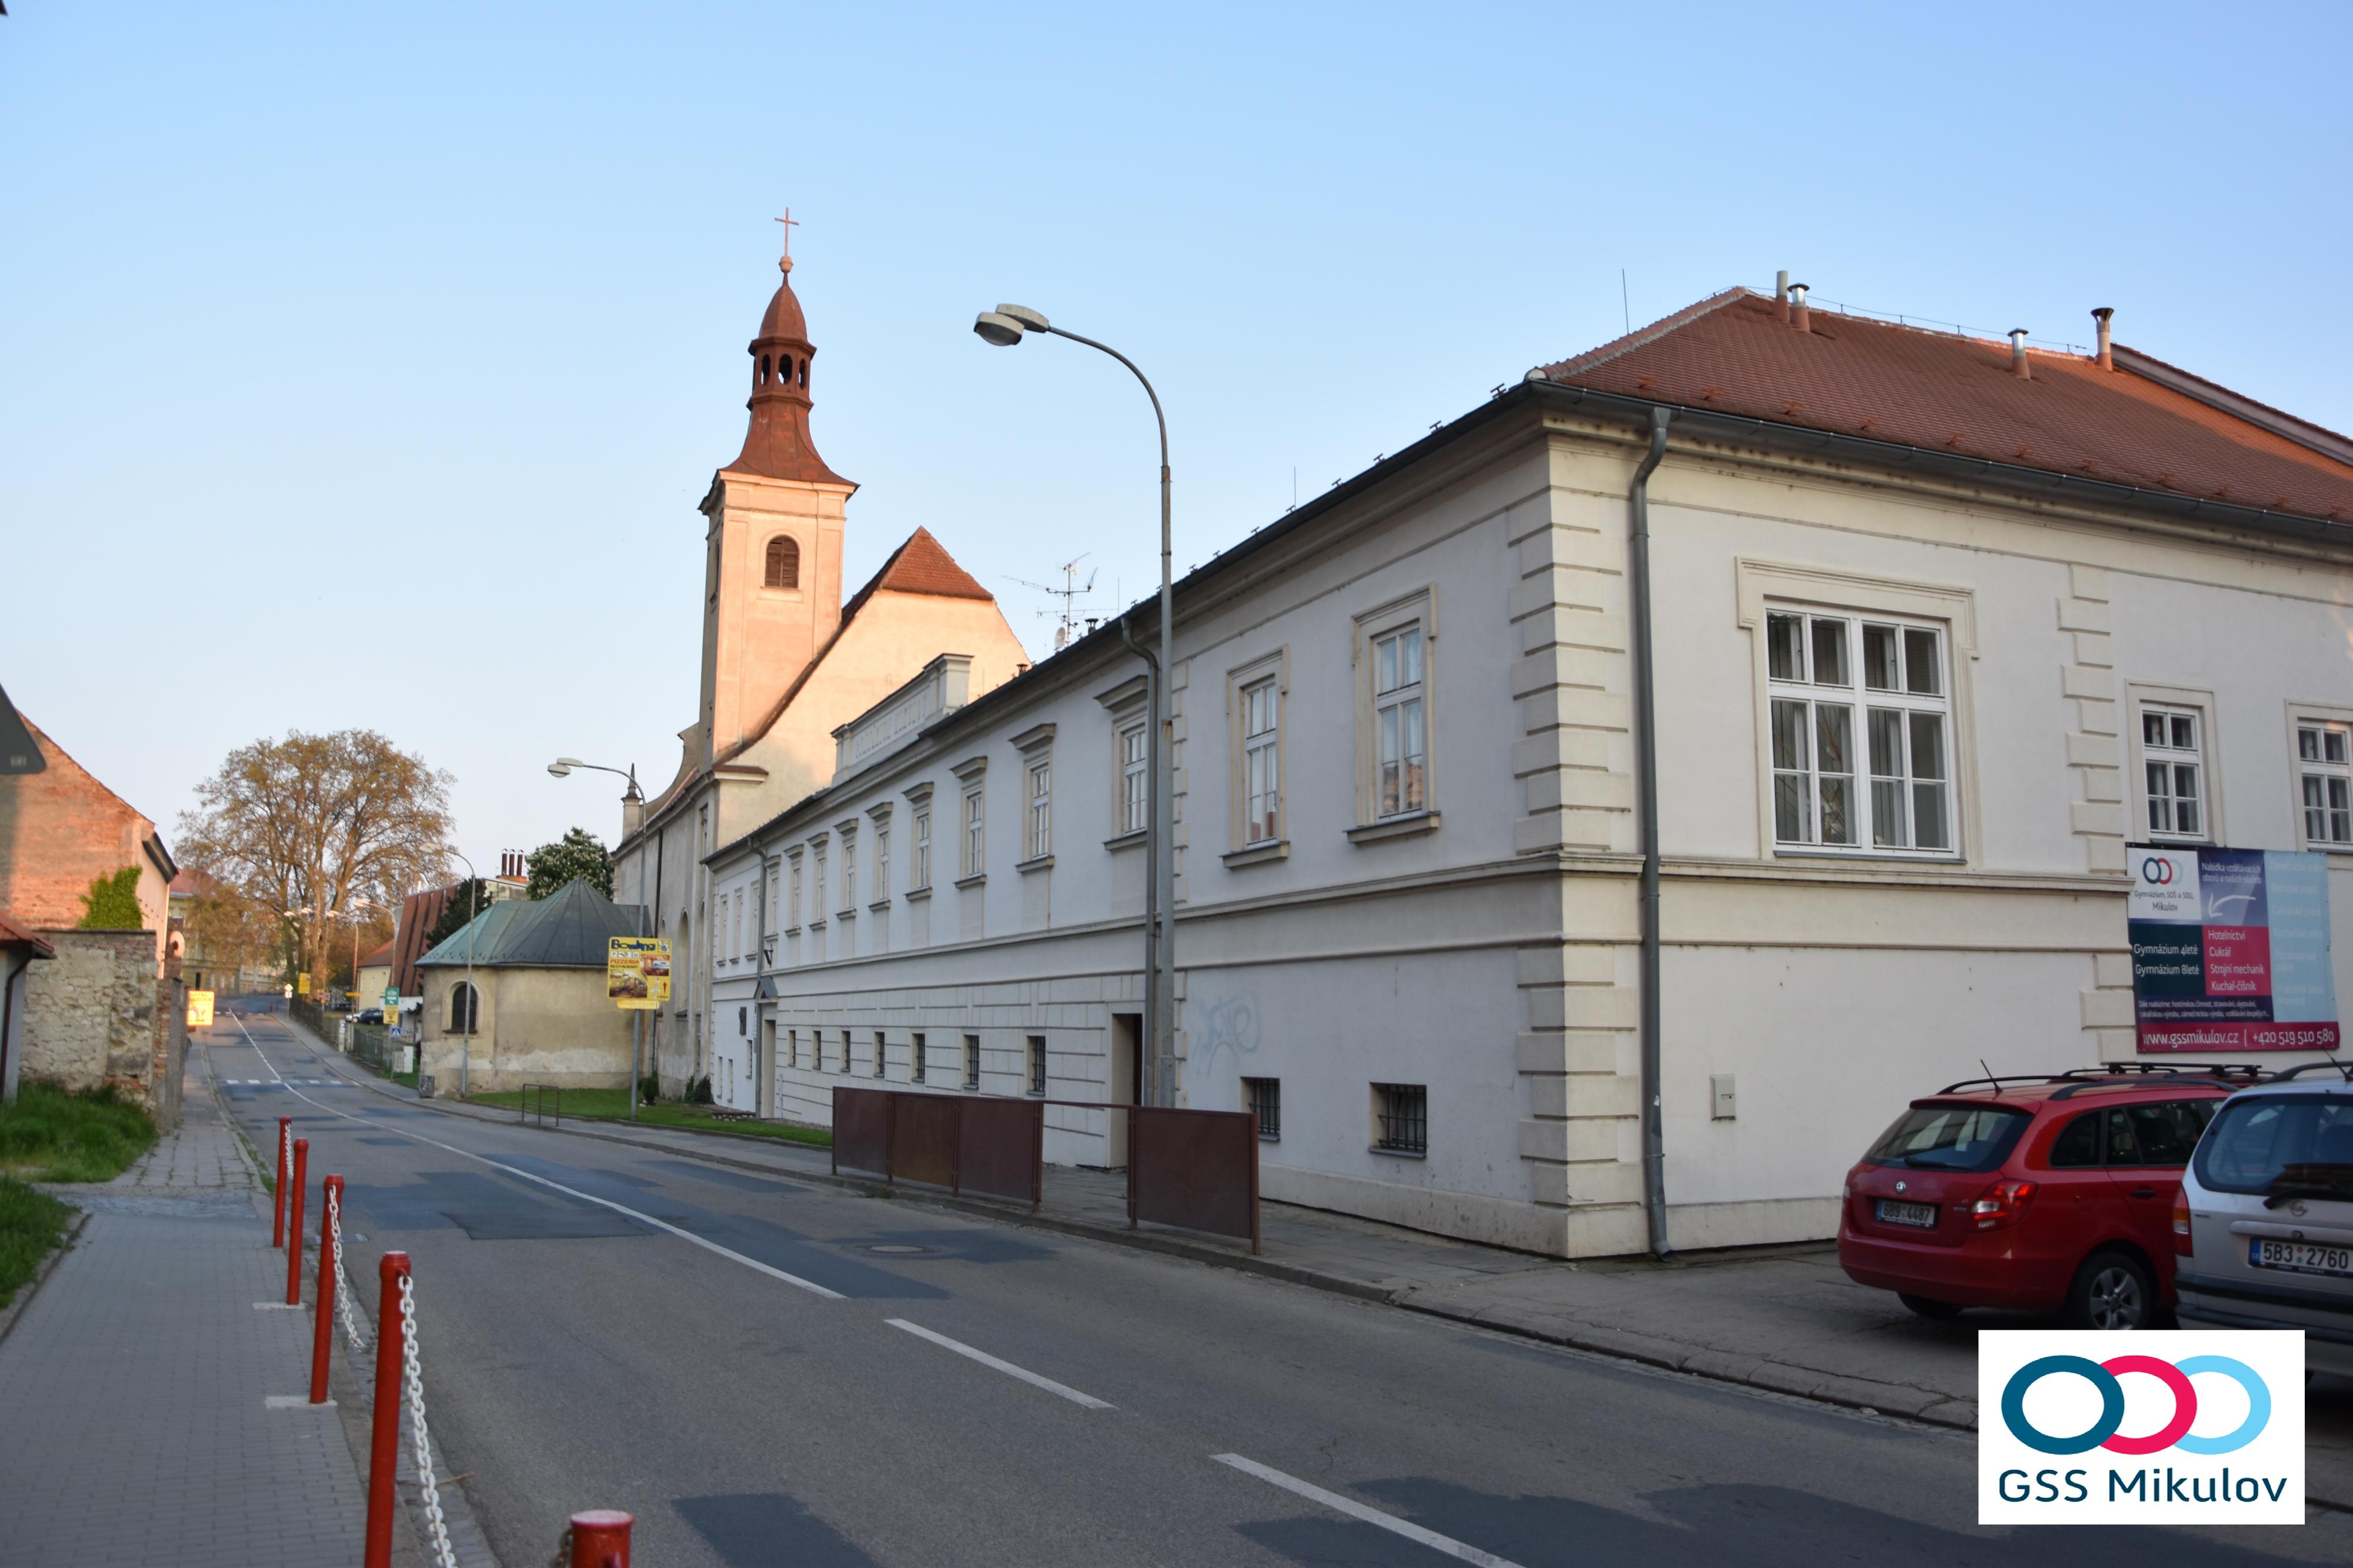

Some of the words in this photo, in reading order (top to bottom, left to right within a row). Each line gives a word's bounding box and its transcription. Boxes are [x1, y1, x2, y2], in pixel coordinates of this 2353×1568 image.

[2202, 862, 2225, 871] Nabídka
[2226, 863, 2261, 873] vzdělávacích
[2202, 873, 2218, 882] oborů
[2225, 874, 2242, 882] našich
[2167, 889, 2176, 899] SOŠ
[2152, 902, 2177, 911] Mikulov
[2208, 930, 2245, 940] Hotelnictví
[611, 939, 656, 951] Bowling
[2134, 943, 2179, 956] Gymnázium
[2181, 944, 2198, 956] 4leté
[2209, 947, 2231, 956] Cukrář
[2135, 964, 2179, 977] Gymnázium
[2181, 965, 2199, 974] 8leté
[2210, 964, 2231, 976] Strojní
[2233, 965, 2265, 974] mechanik
[2212, 980, 2257, 990] Kuchař-číšník
[2143, 1029, 2239, 1048] www.gssmikulov.cz
[2252, 1032, 2277, 1045] +420
[2278, 1032, 2295, 1045] 519
[2298, 1031, 2314, 1045] 510
[2317, 1029, 2334, 1045] 580
[1907, 1207, 1930, 1222] 4487
[2264, 1242, 2293, 1263] 5B3
[2306, 1247, 2349, 1269] 2760
